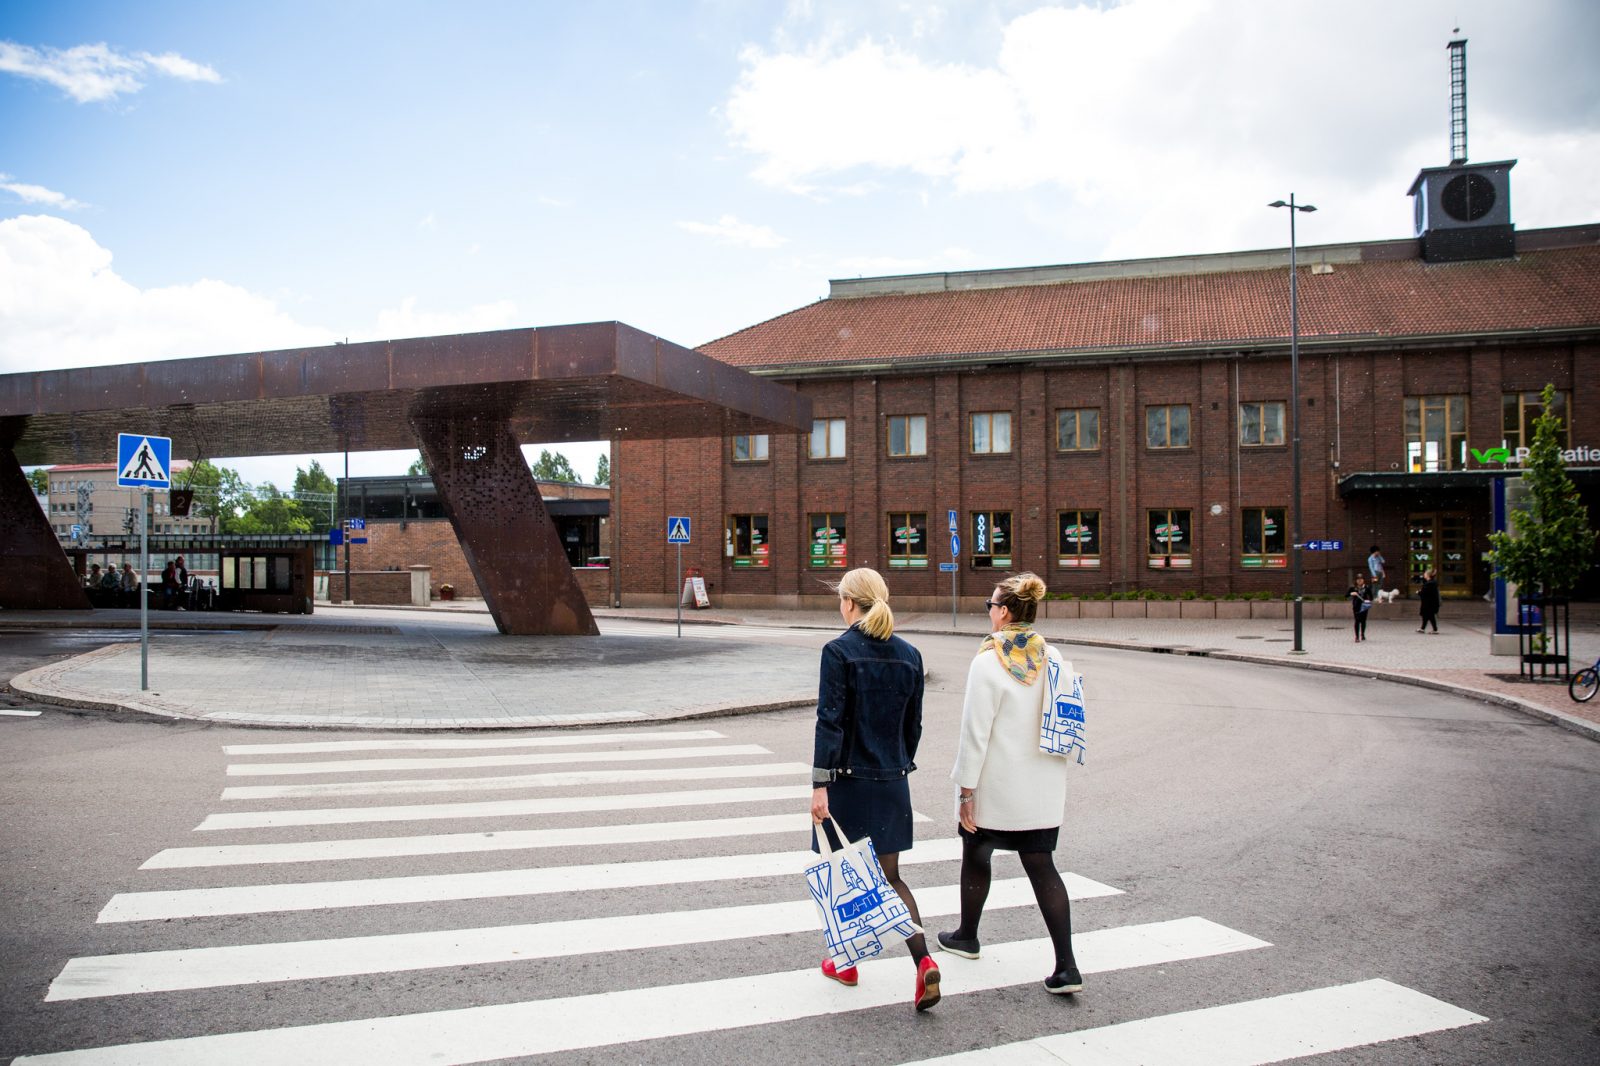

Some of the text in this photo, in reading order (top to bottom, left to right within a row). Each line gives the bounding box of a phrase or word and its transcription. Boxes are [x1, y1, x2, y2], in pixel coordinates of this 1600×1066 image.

[1470, 447, 1511, 464] VR
[176, 496, 186, 508] 2
[1333, 541, 1340, 549] E
[841, 892, 878, 918] LAHTI
